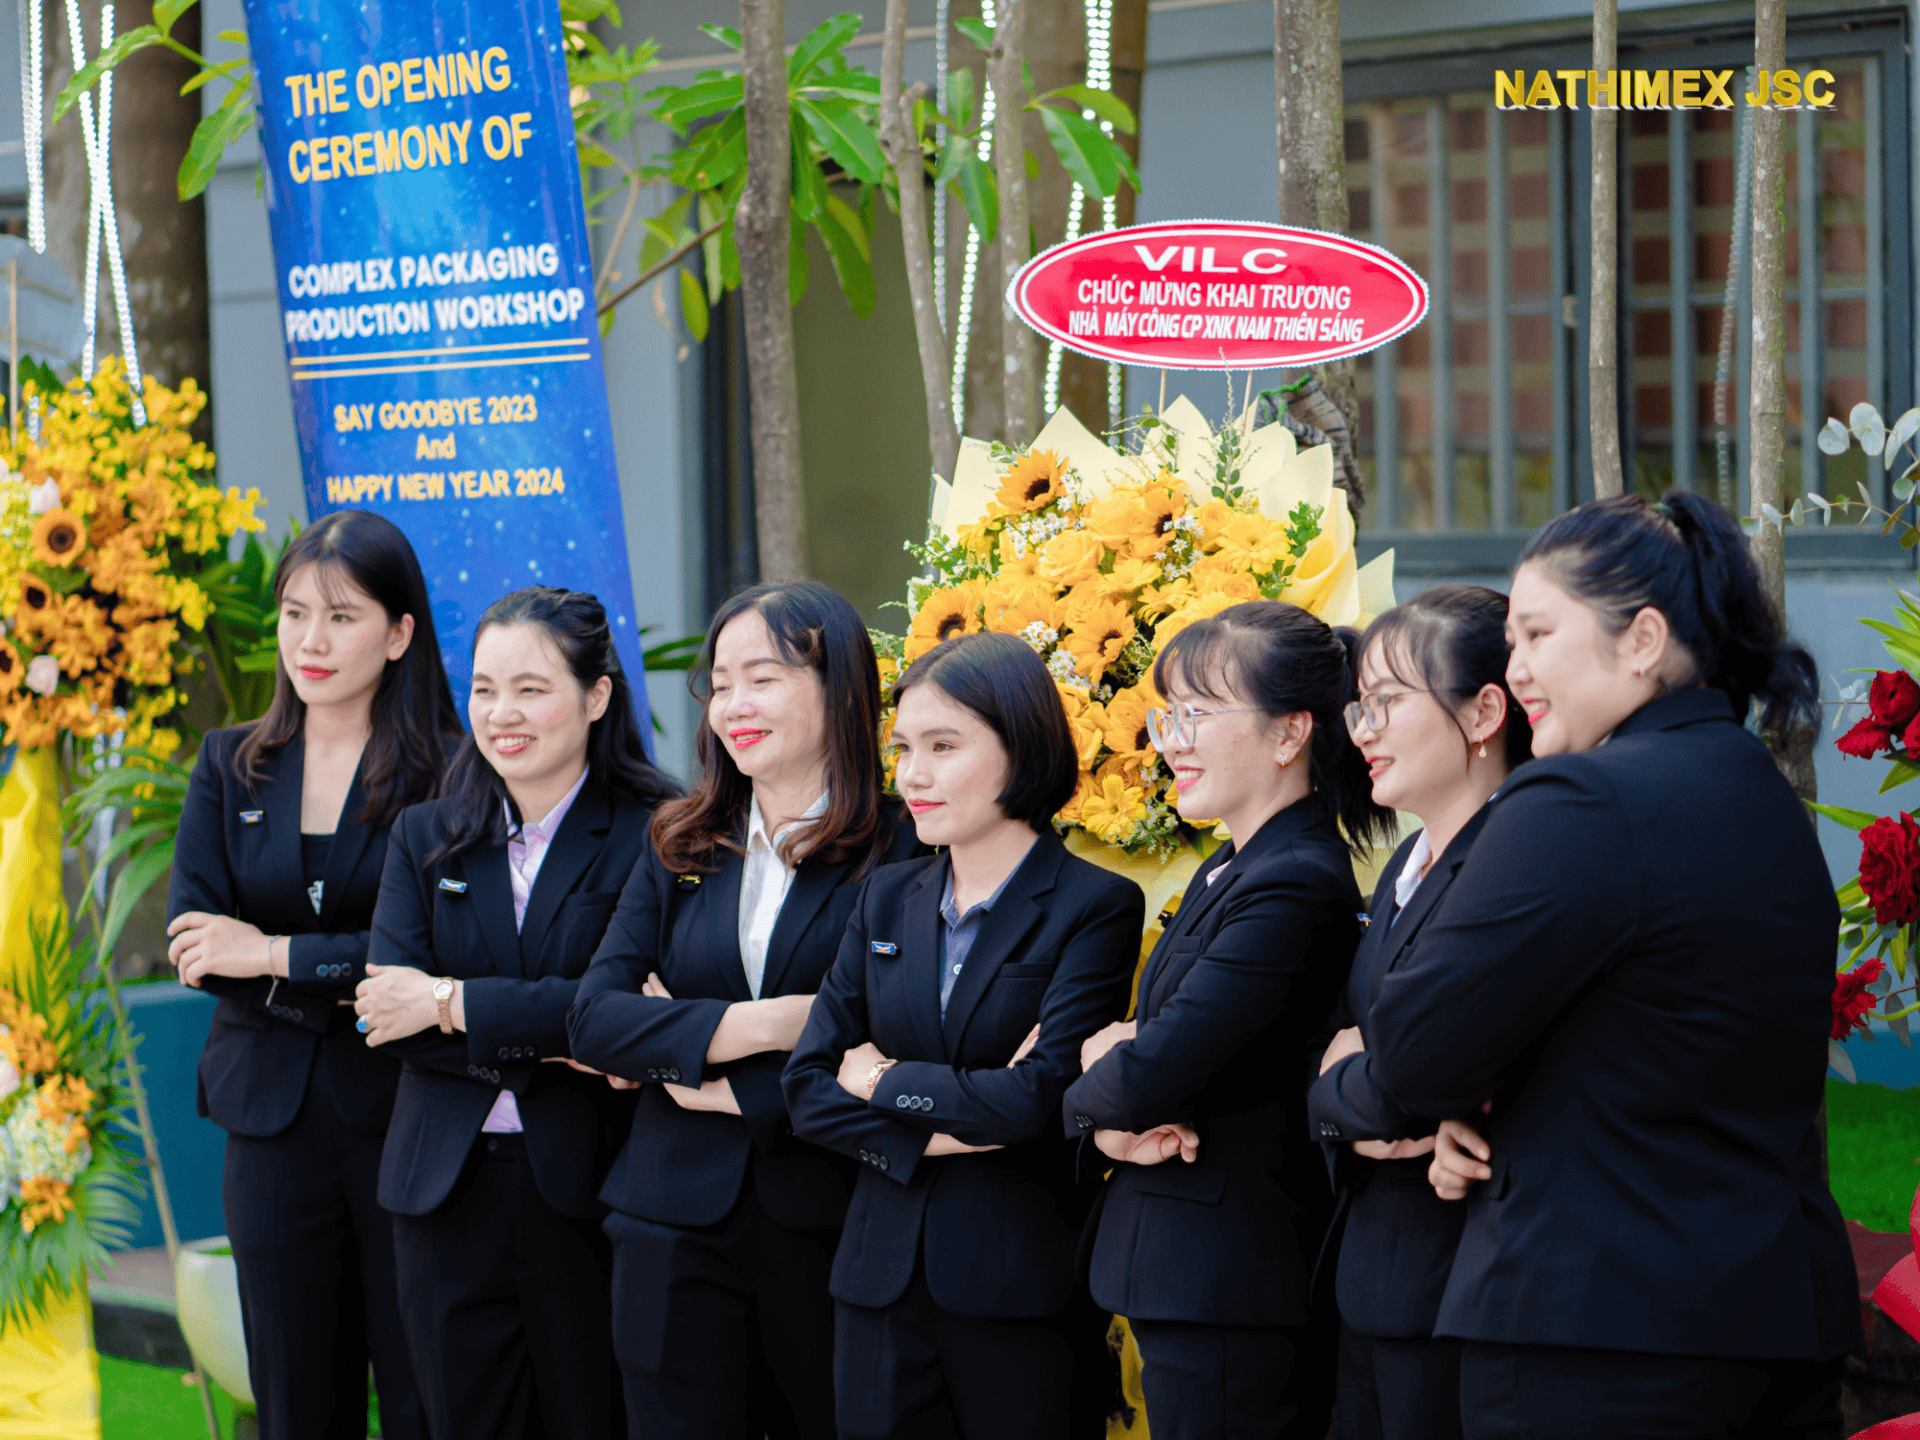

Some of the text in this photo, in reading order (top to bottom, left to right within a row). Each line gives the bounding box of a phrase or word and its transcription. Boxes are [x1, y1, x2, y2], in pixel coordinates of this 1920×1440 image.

[285, 46, 512, 118] THE OPENING
[288, 112, 532, 184] CEREMONY OF
[288, 243, 559, 298] COMPLEX PACKAGING
[1133, 245, 1288, 274] VILC
[1078, 274, 1351, 310] CHÚC MỪNG KHAI TRƯƠNG
[285, 287, 585, 342] PRODUCTION WORKSHOP
[1069, 305, 1364, 342] NHÀ MÁY CÔNG CP XNK NAM THIÊN SÁNG
[333, 394, 538, 432] SAY GOODBYE 2023
[416, 432, 456, 460] And
[326, 467, 565, 503] HAPPY NEW YEAR 2024
